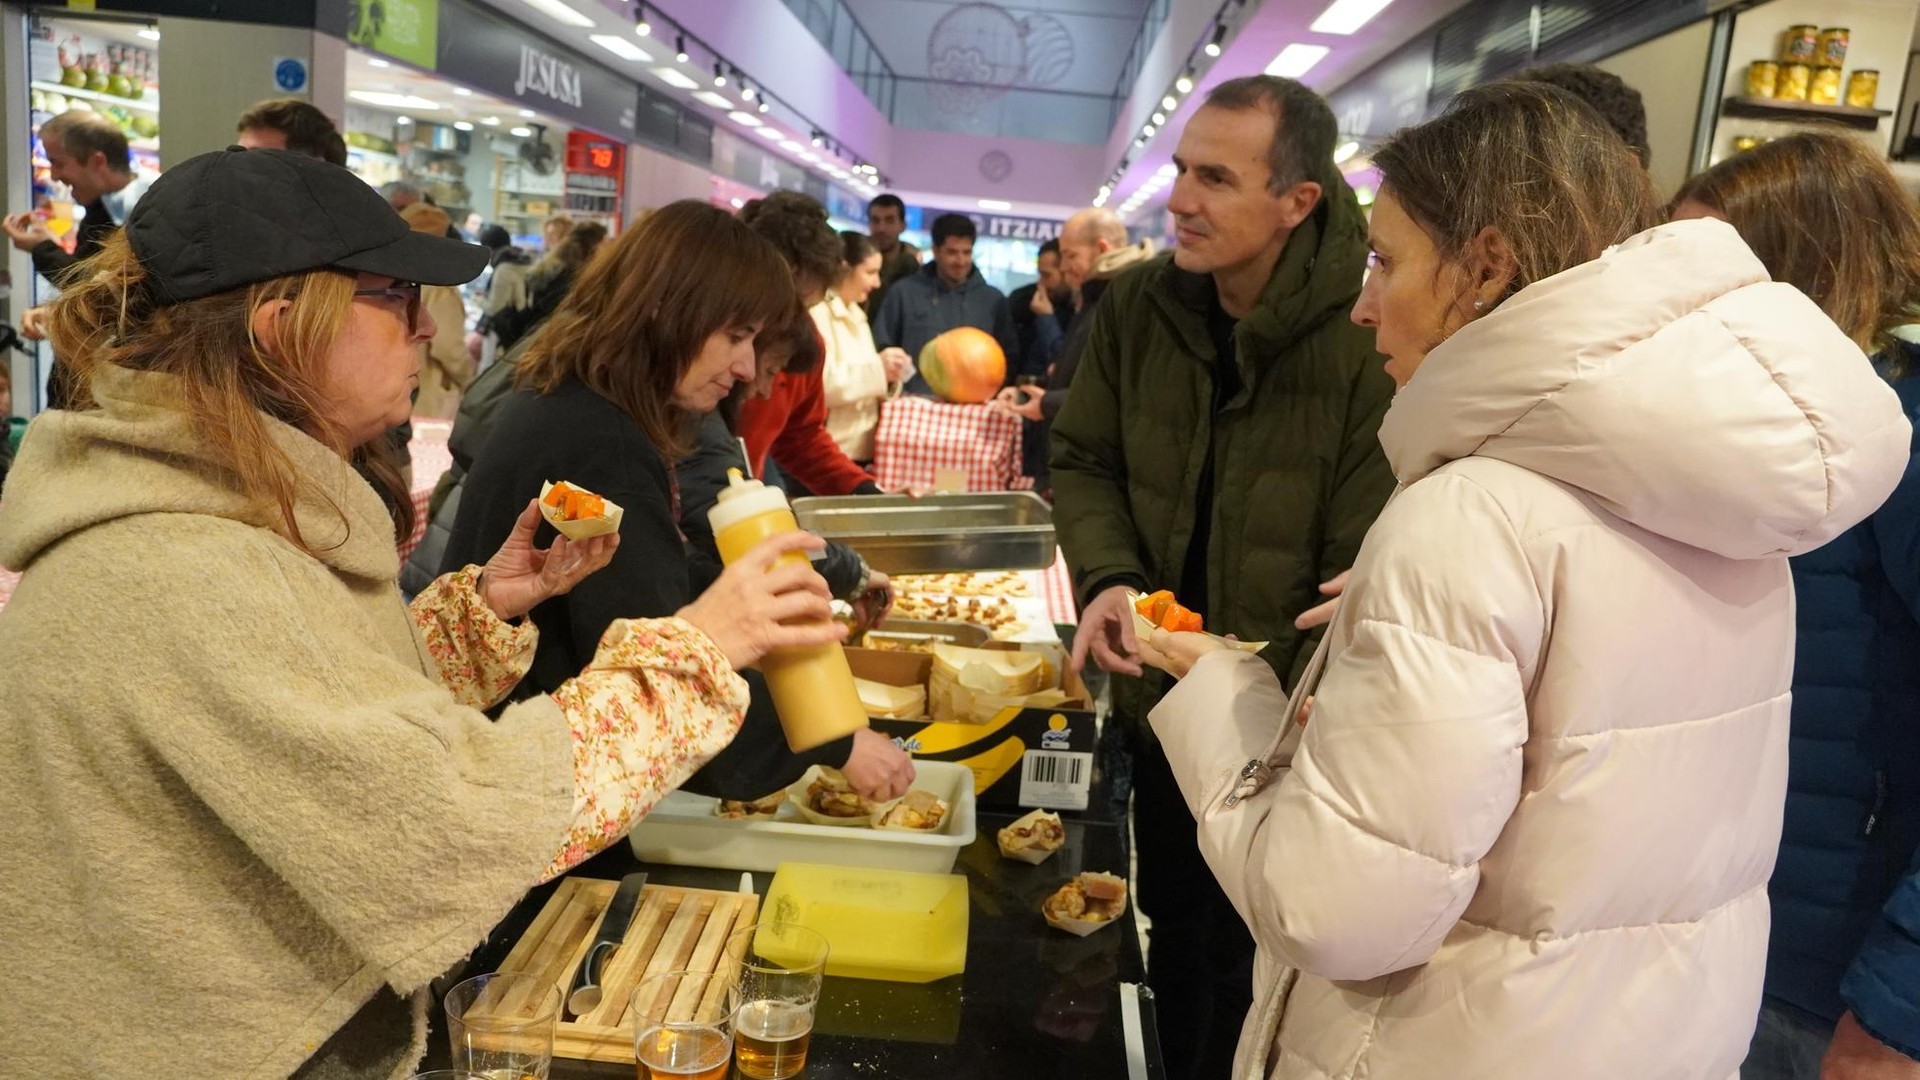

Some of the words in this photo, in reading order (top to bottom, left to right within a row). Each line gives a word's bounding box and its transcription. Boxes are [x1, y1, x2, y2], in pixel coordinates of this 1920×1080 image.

[515, 45, 582, 108] JESUSA
[590, 148, 613, 168] 78
[990, 217, 1063, 240] ITZIA
